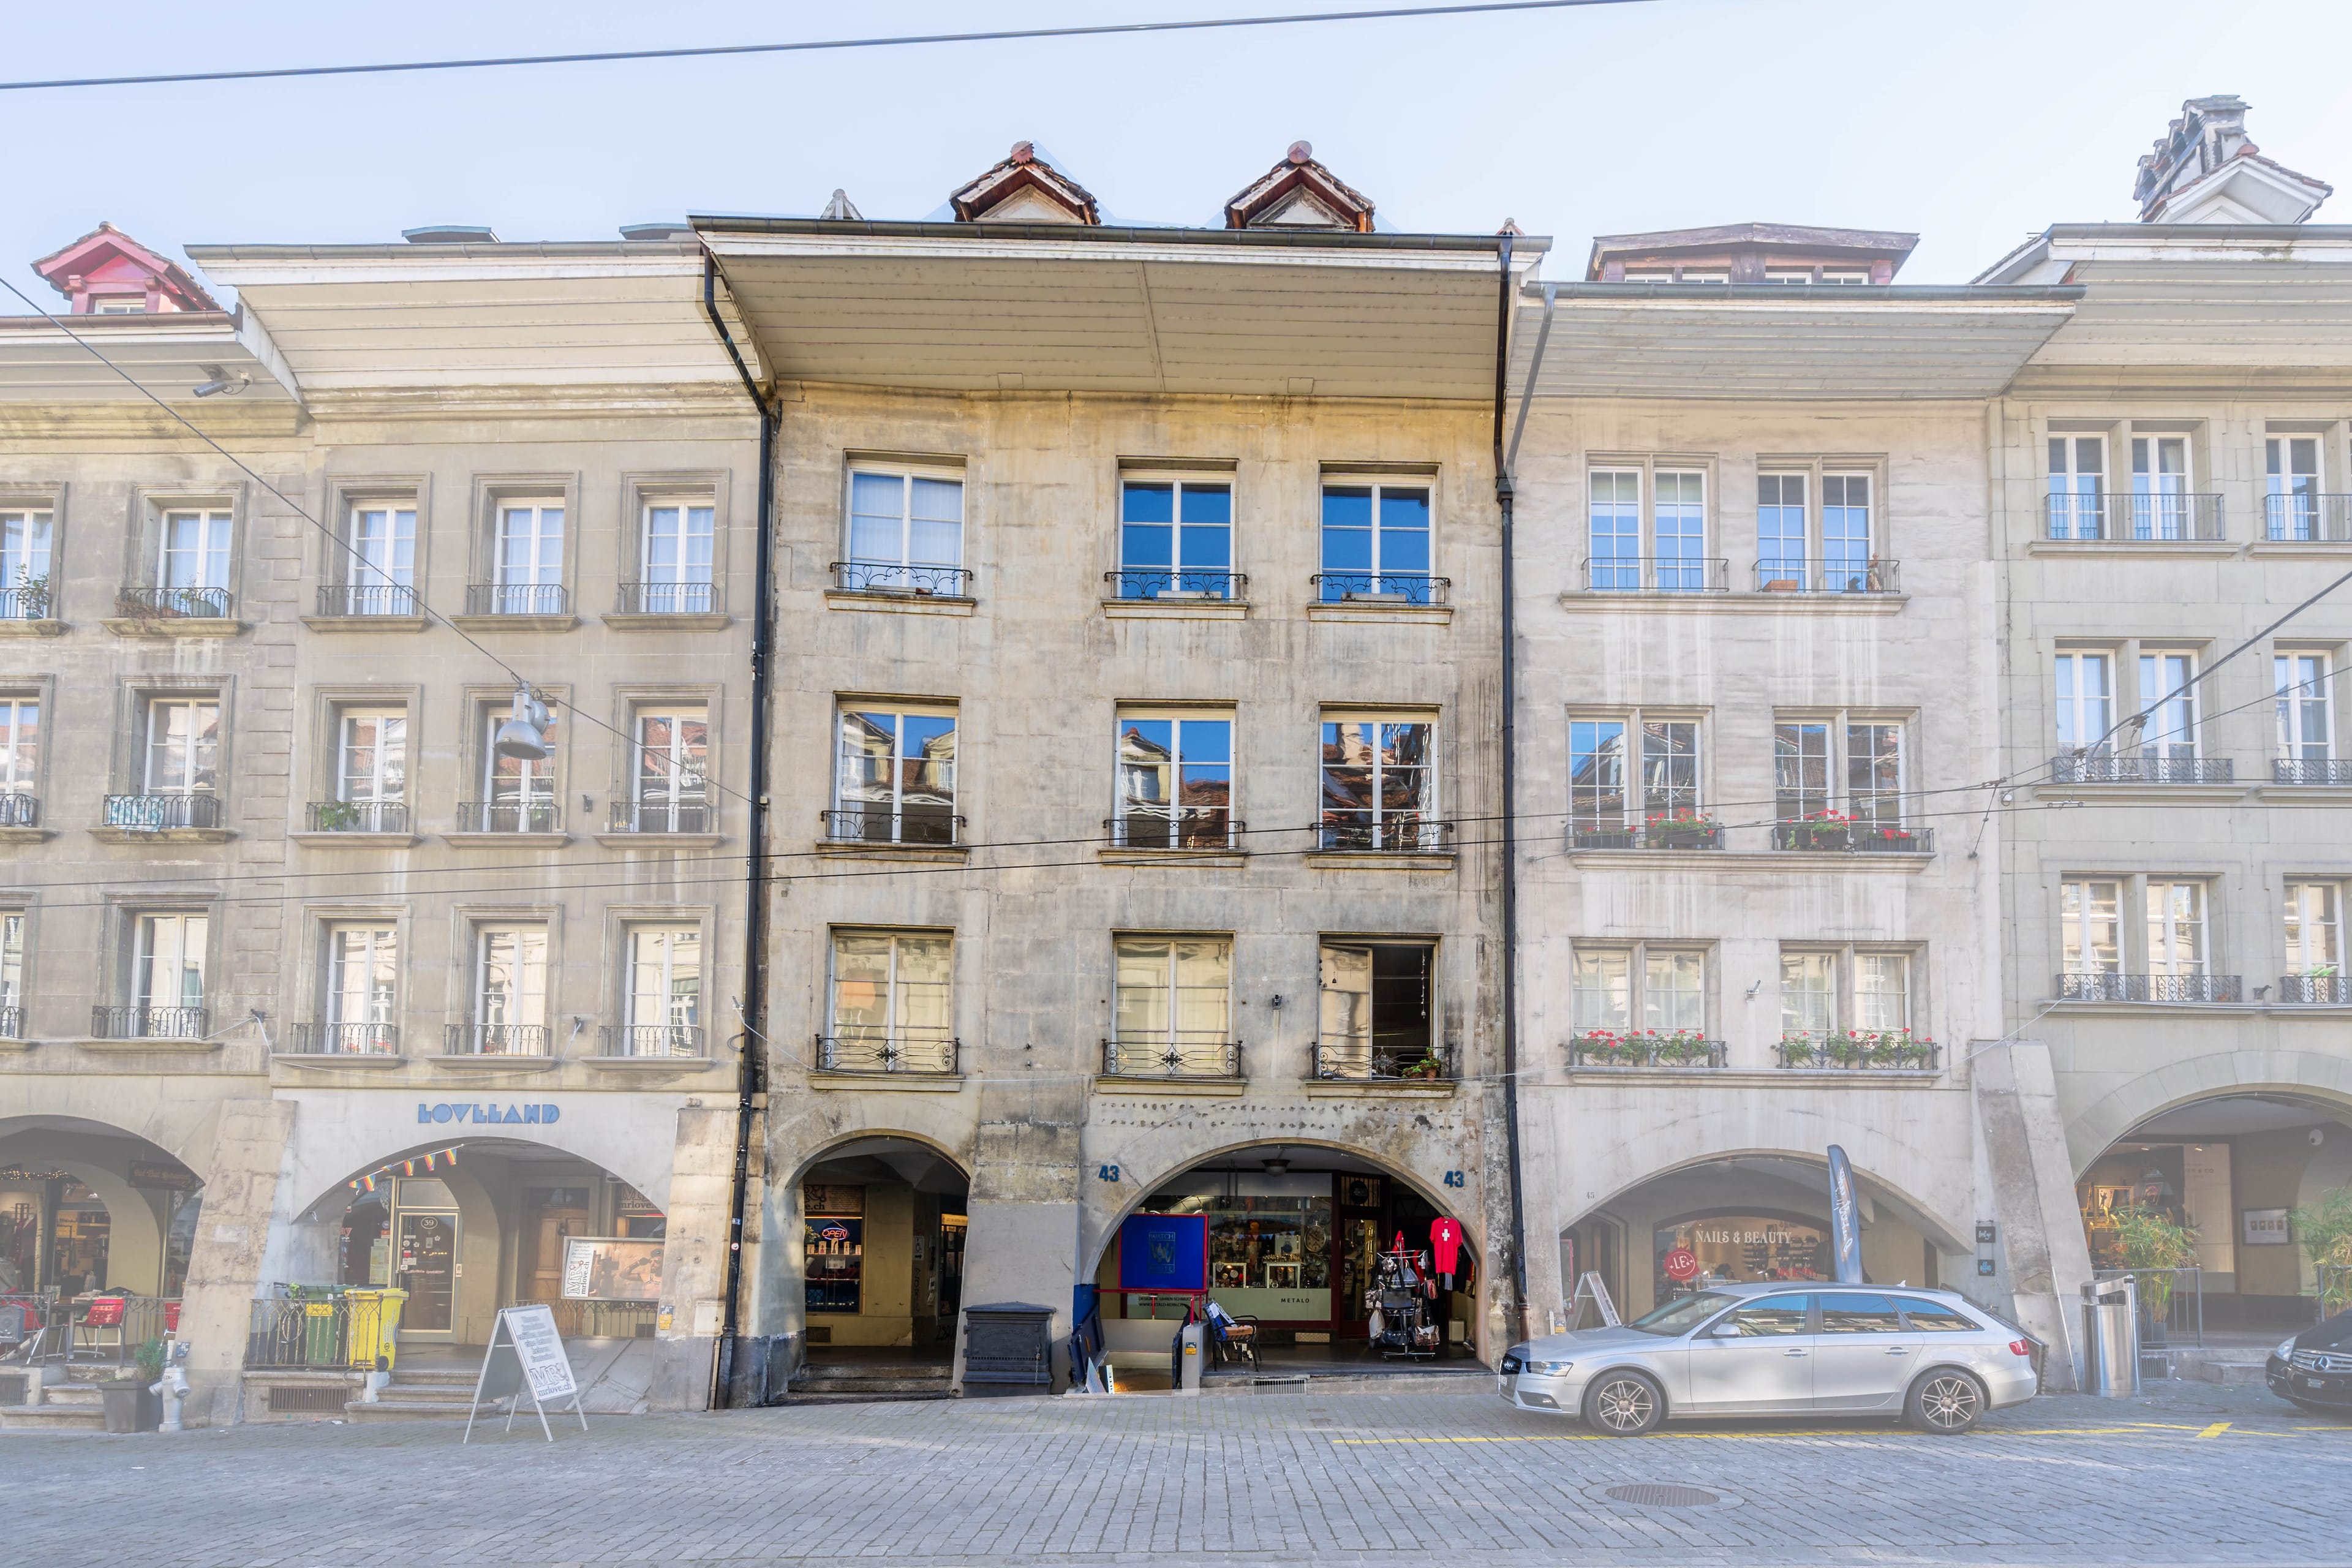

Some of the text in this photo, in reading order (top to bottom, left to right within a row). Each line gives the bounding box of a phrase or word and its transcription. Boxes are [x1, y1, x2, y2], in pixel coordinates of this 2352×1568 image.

[418, 1104, 560, 1124] LOVELAND
[1099, 1166, 1119, 1182] 43
[1444, 1170, 1464, 1188] 43
[1695, 1231, 1792, 1244] NAILS & BEAUTY
[538, 1382, 572, 1396] mrlove.ch
